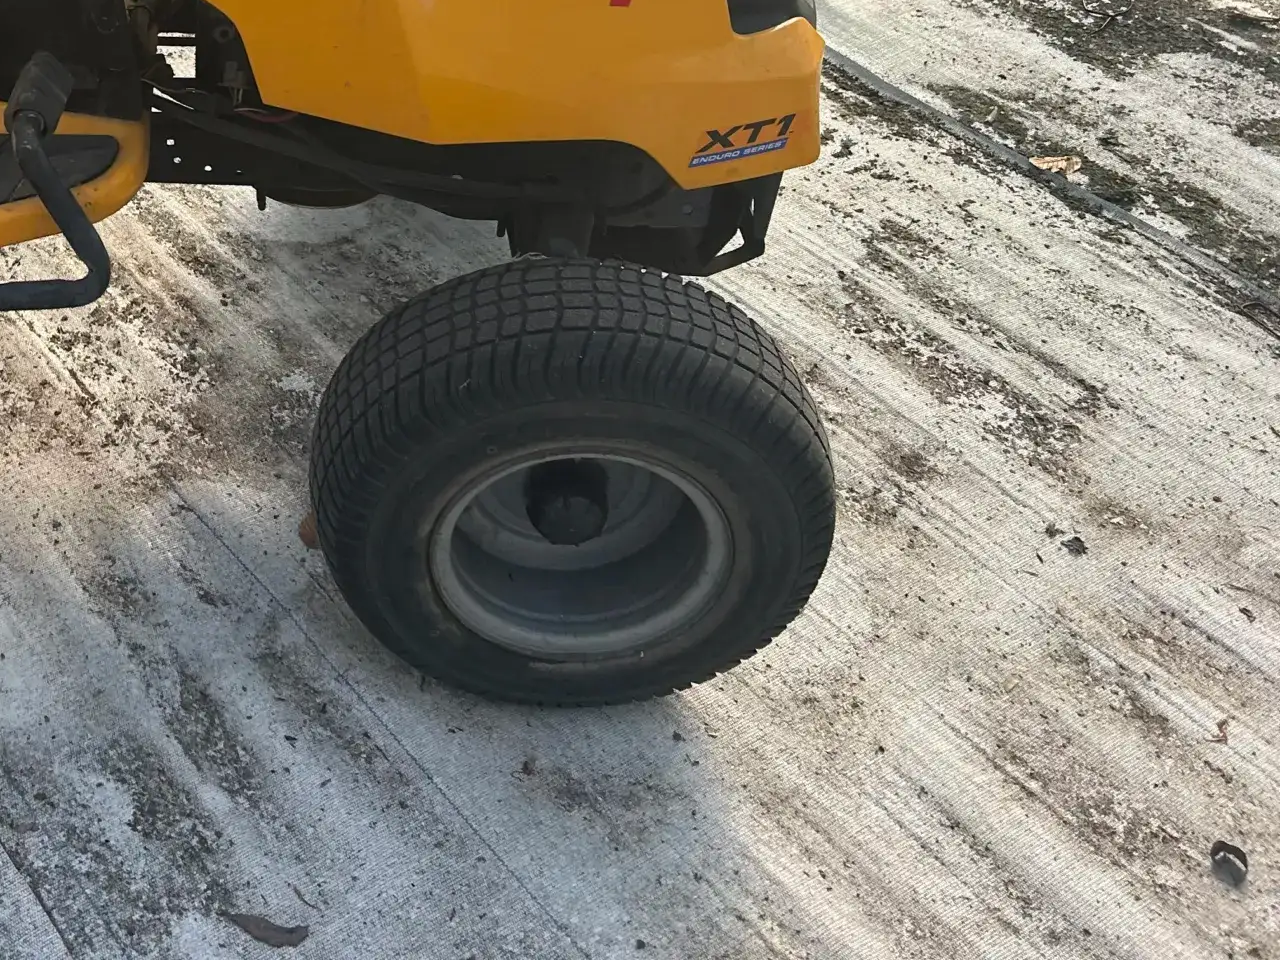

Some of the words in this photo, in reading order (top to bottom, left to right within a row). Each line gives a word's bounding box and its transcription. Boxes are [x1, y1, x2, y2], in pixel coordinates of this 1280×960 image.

[695, 113, 796, 154] XT1
[692, 149, 740, 165] ENDURO
[743, 140, 782, 155] SERIES
